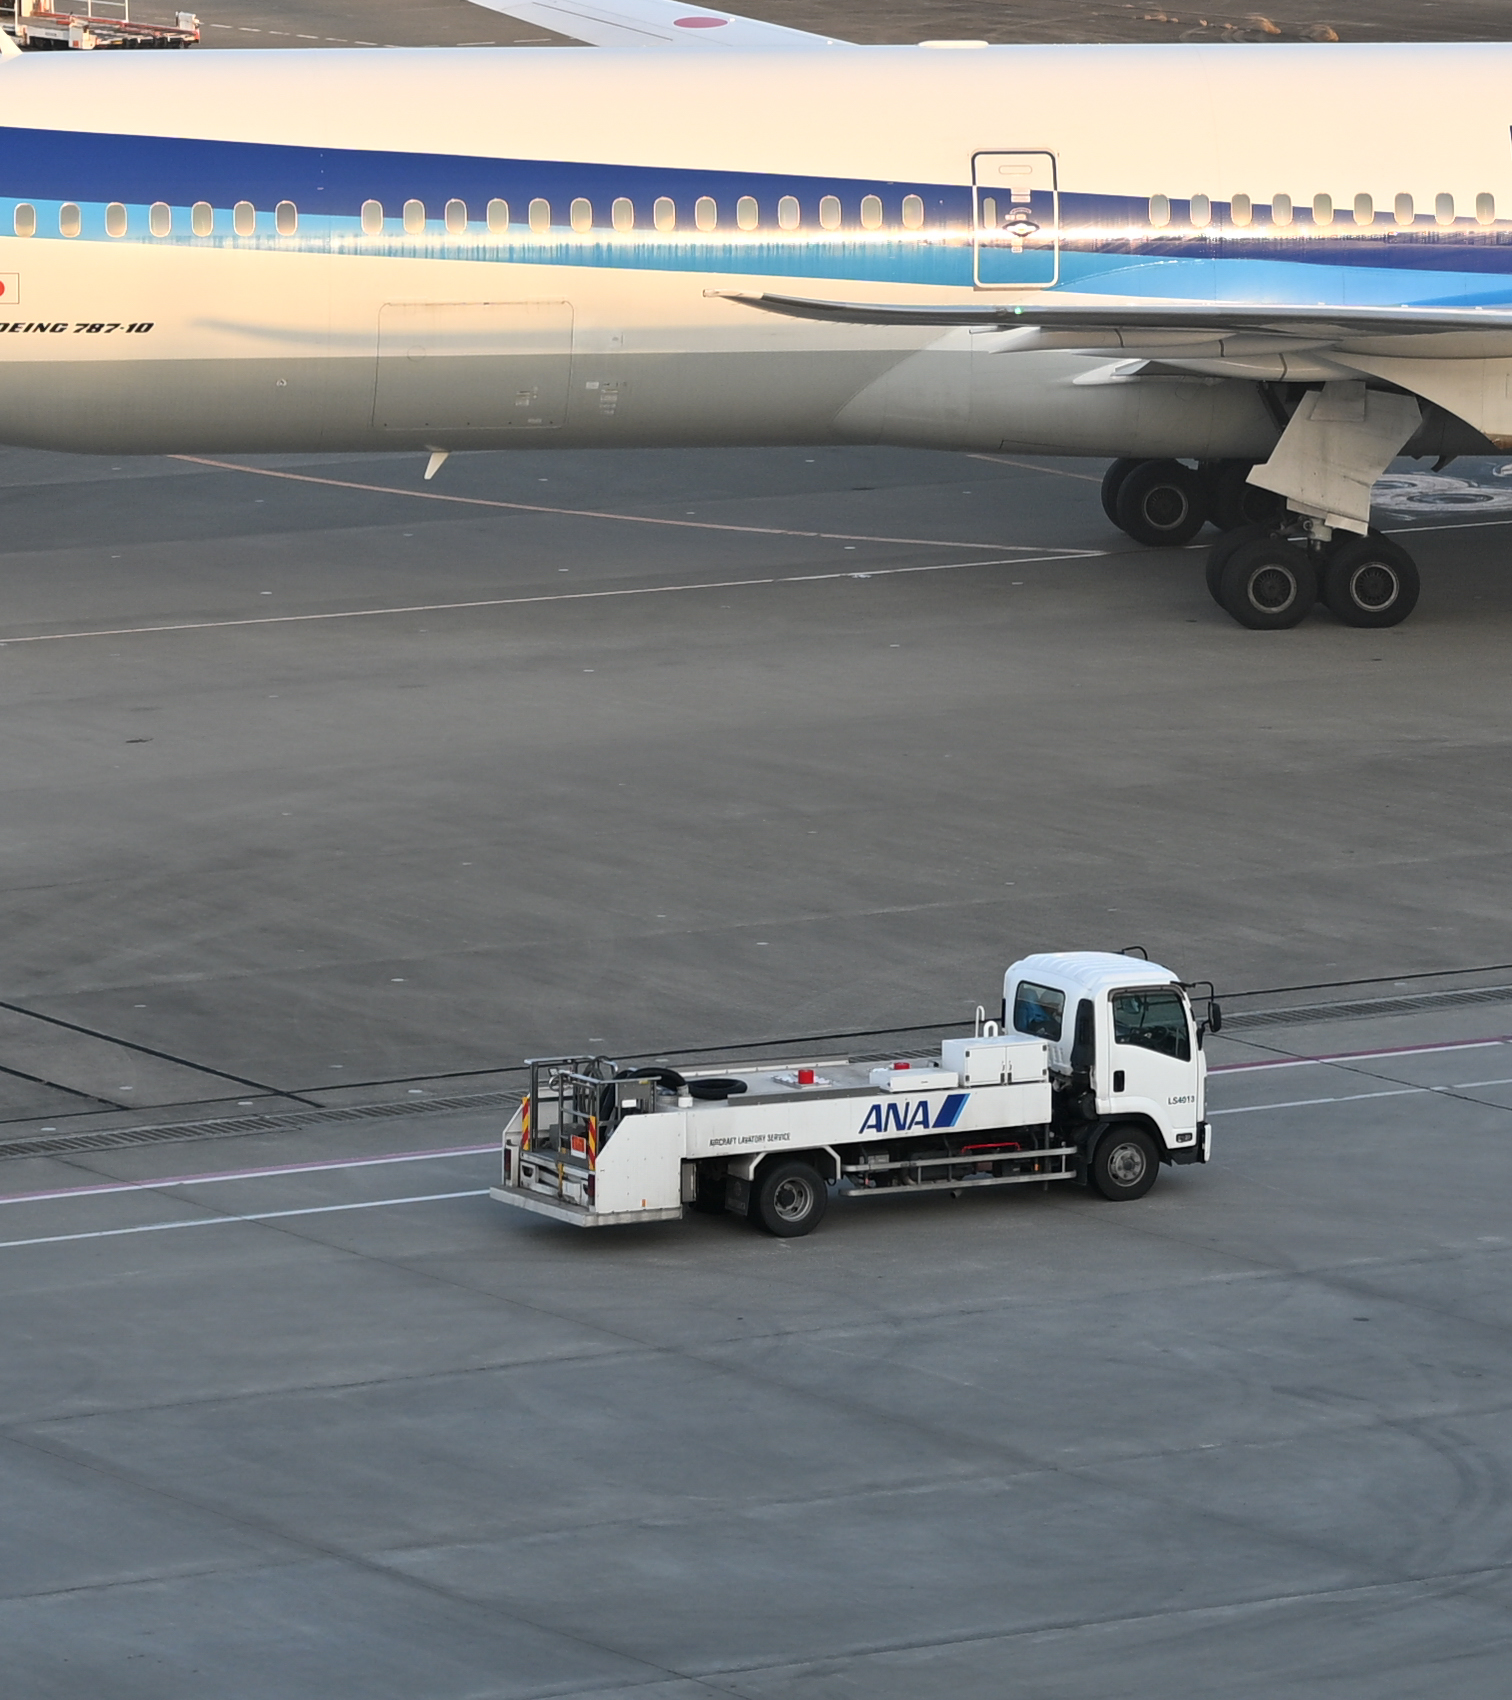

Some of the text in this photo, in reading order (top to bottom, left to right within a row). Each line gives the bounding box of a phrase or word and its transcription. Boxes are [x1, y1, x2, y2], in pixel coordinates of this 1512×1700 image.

[73, 321, 155, 334] 787-10
[1168, 1095, 1195, 1105] LS4013
[858, 1100, 930, 1135] ANA
[709, 1132, 791, 1147] AIRCRAFT LAVATORY SERVICE
